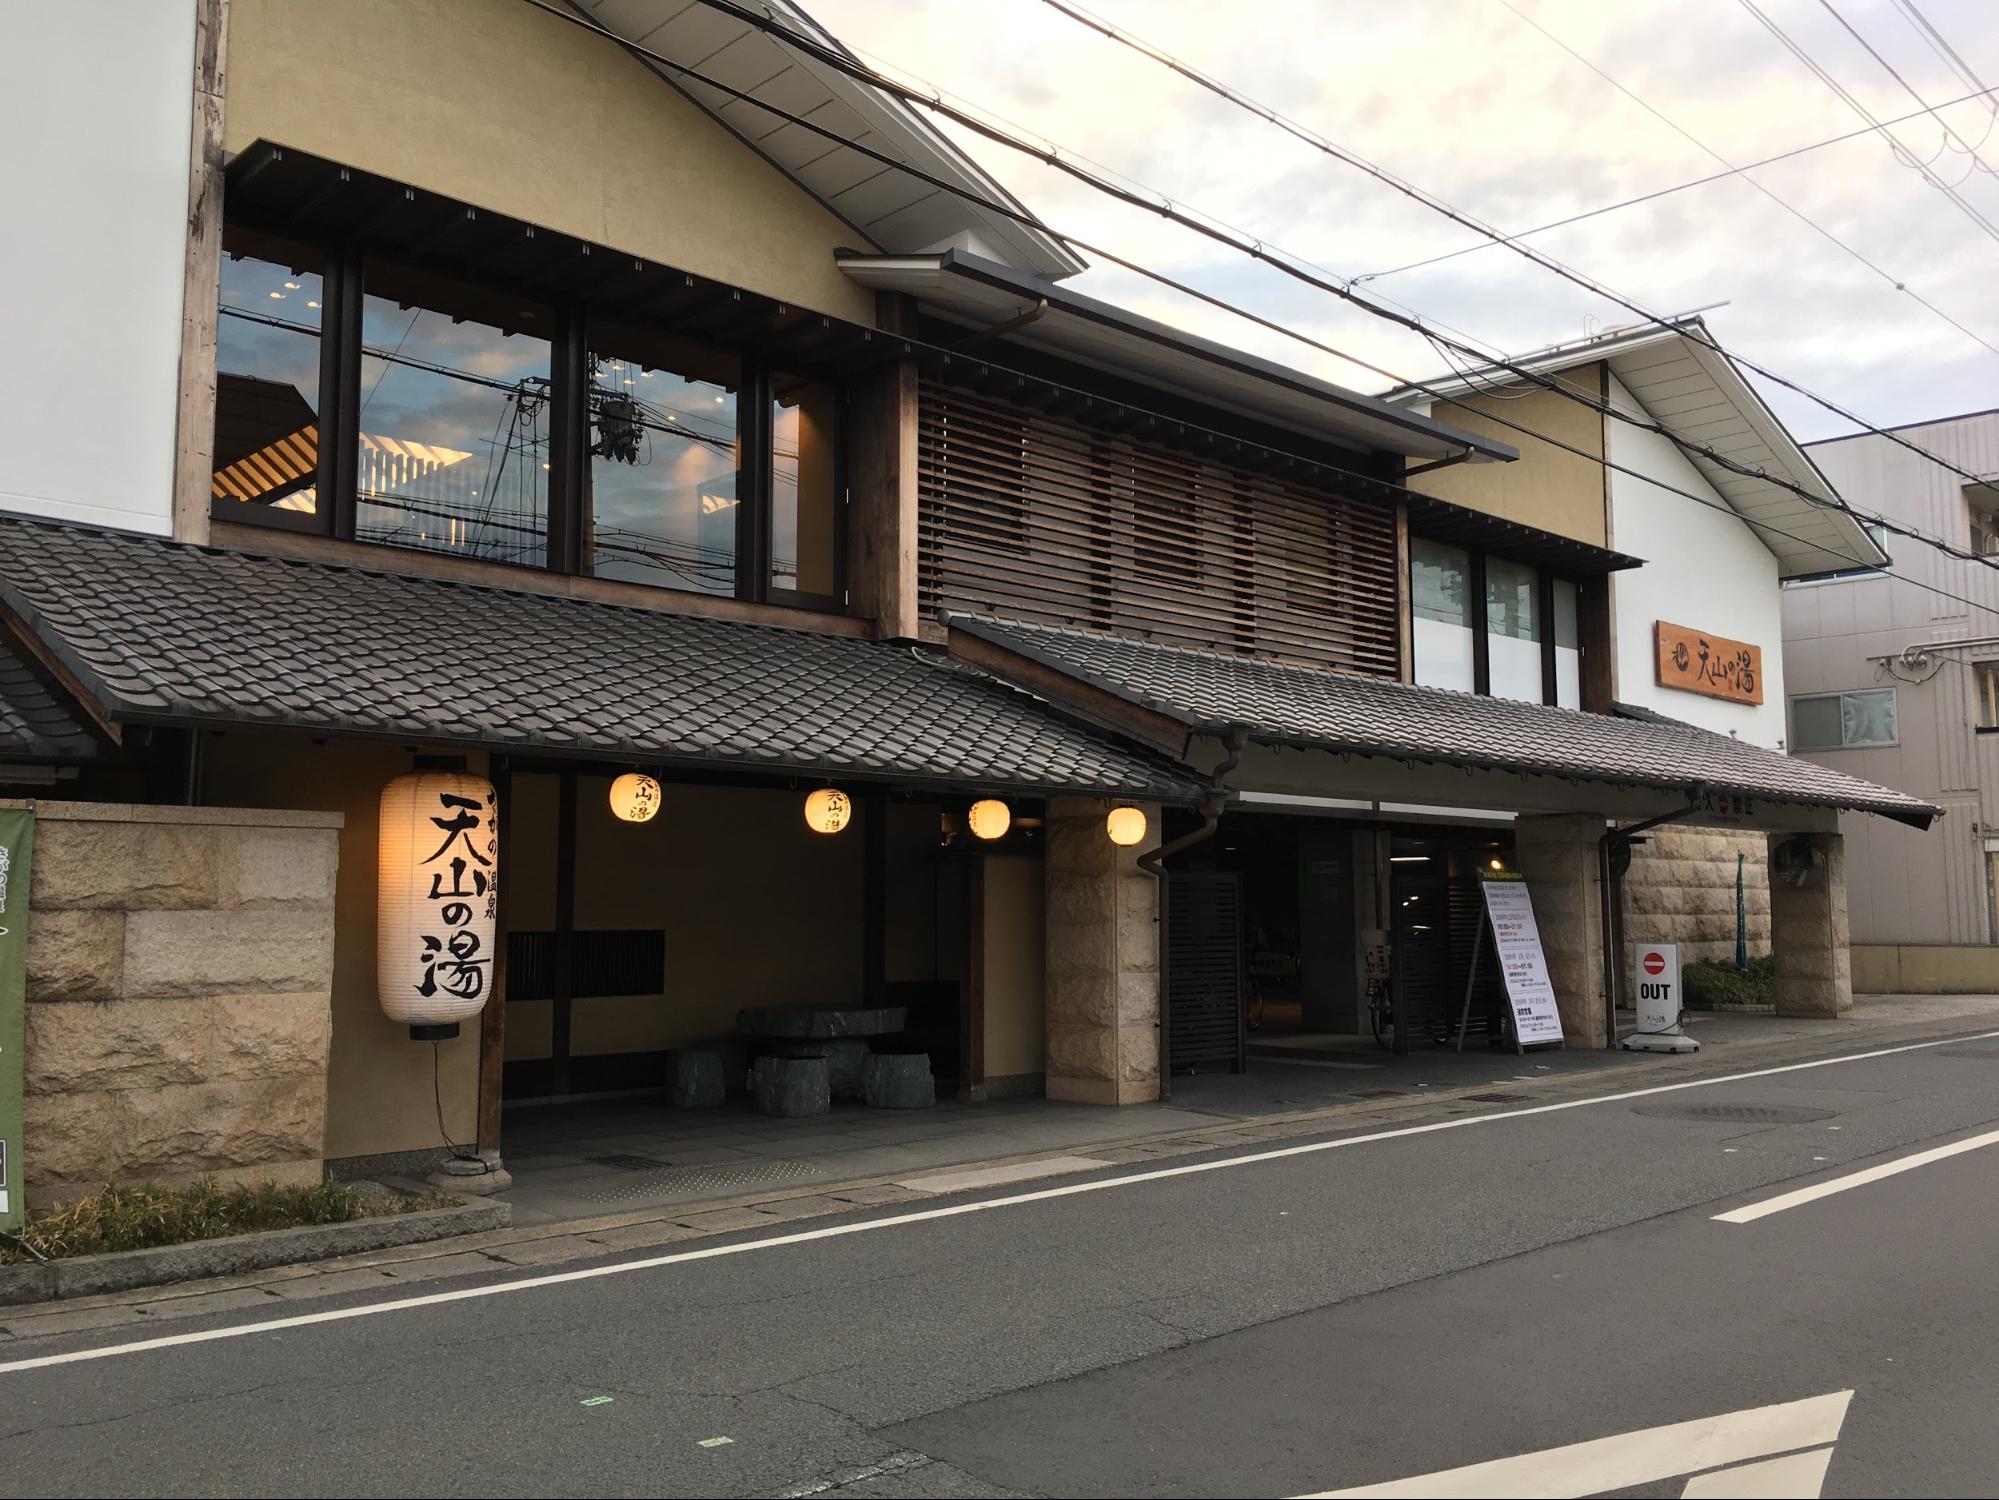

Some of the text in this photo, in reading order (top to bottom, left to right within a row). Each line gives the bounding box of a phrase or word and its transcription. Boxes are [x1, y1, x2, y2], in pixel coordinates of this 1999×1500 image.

[1697, 638, 1754, 693] 天山の湯
[629, 775, 654, 820] 天山の湯
[825, 790, 844, 830] 天山の湯
[412, 792, 493, 999] 天山の湯
[1640, 983, 1671, 1000] OUT
